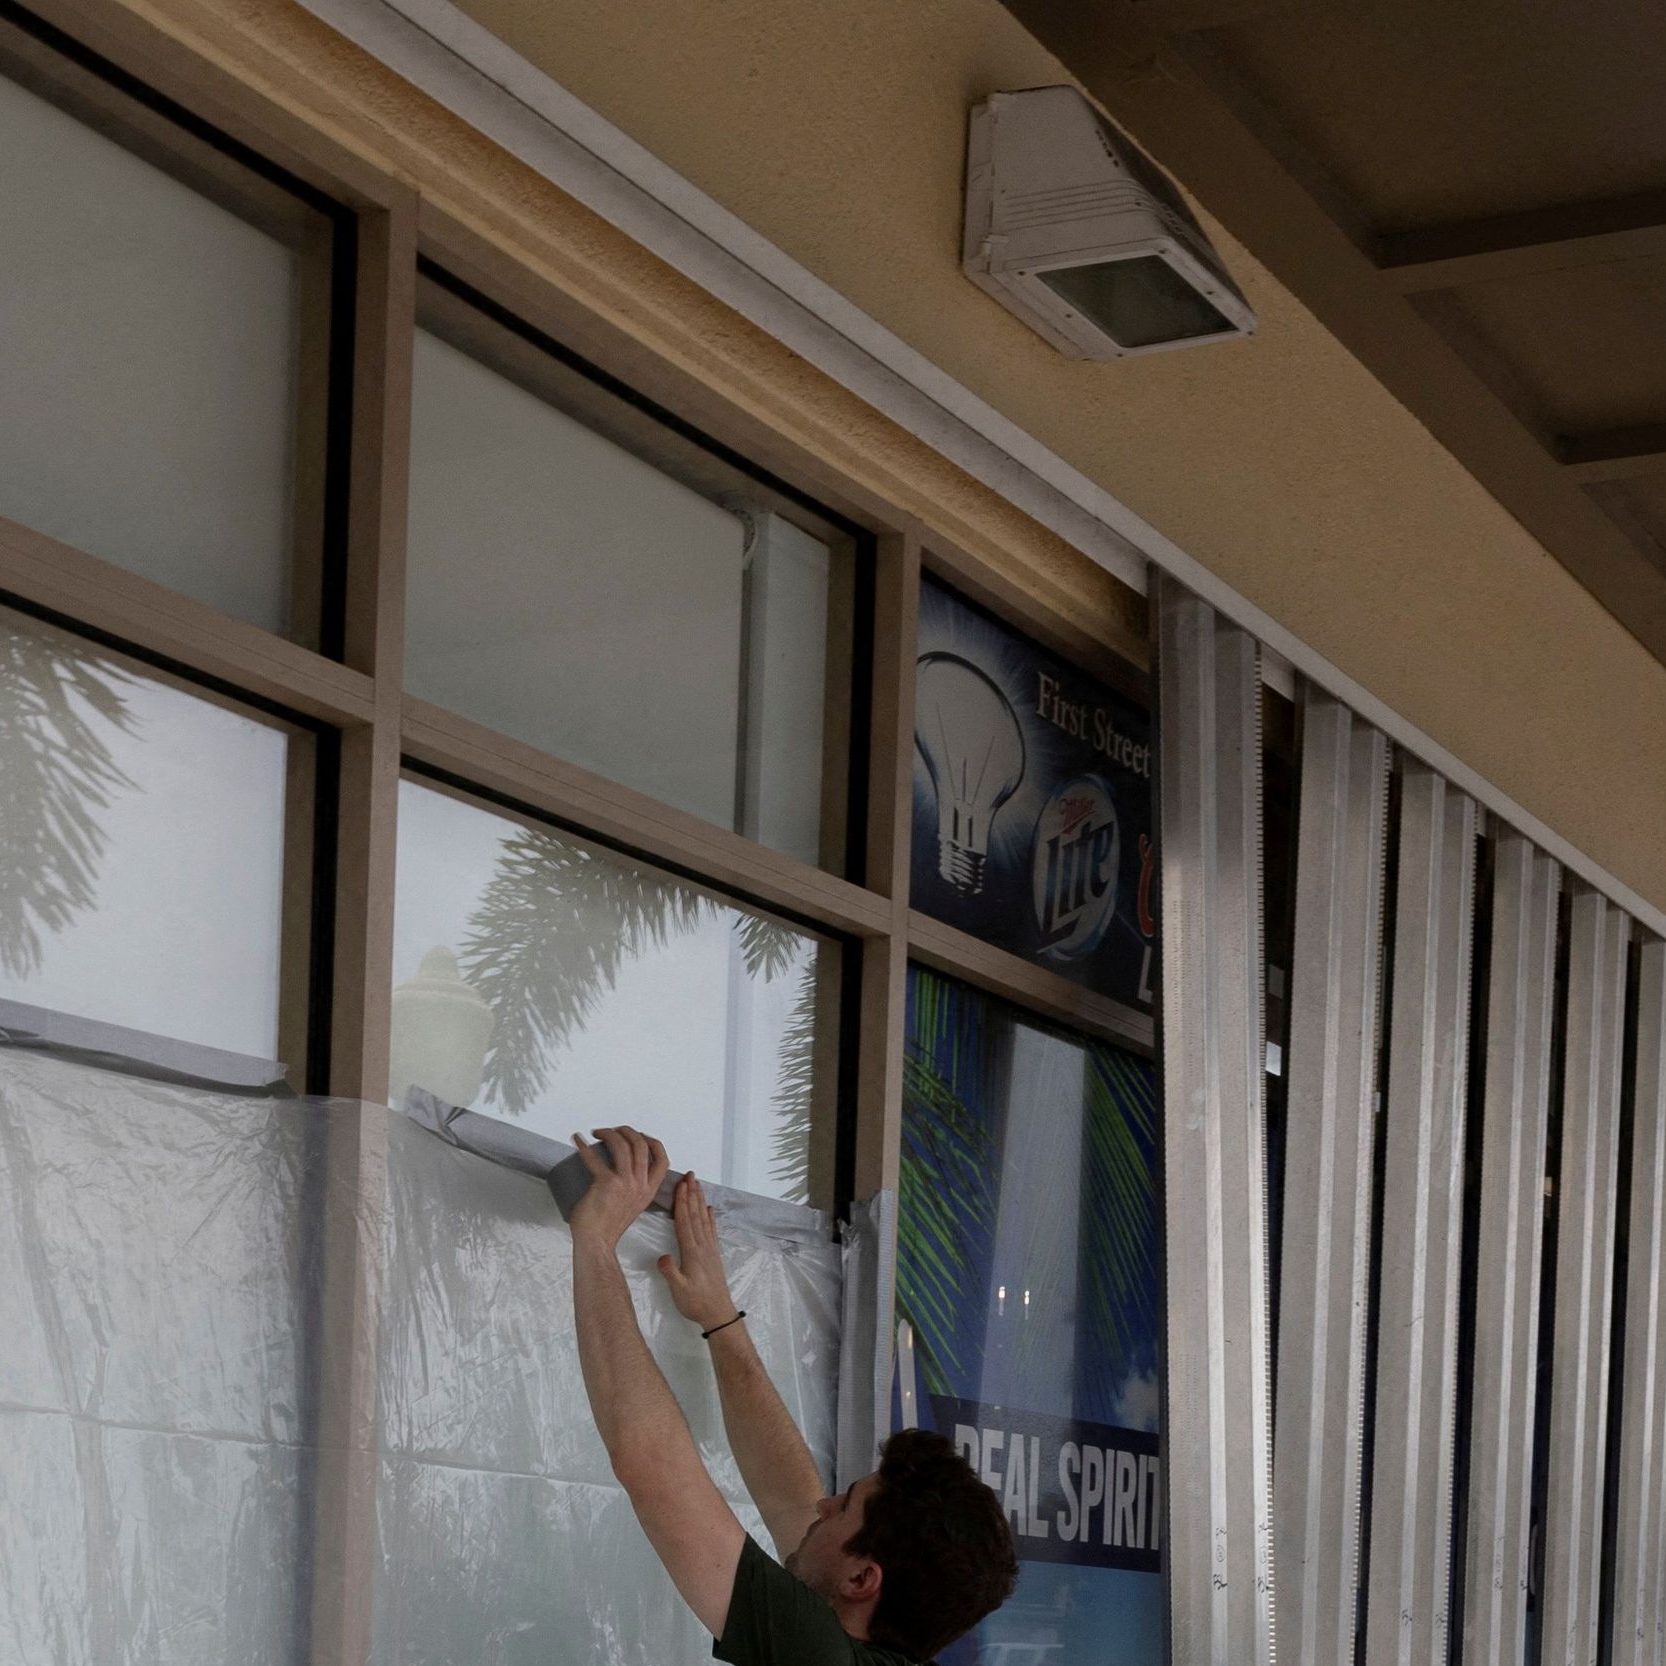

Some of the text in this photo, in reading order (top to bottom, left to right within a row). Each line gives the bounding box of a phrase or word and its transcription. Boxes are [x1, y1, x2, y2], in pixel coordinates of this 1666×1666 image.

[1035, 671, 1151, 778] First Street
[1037, 820, 1115, 952] Lite
